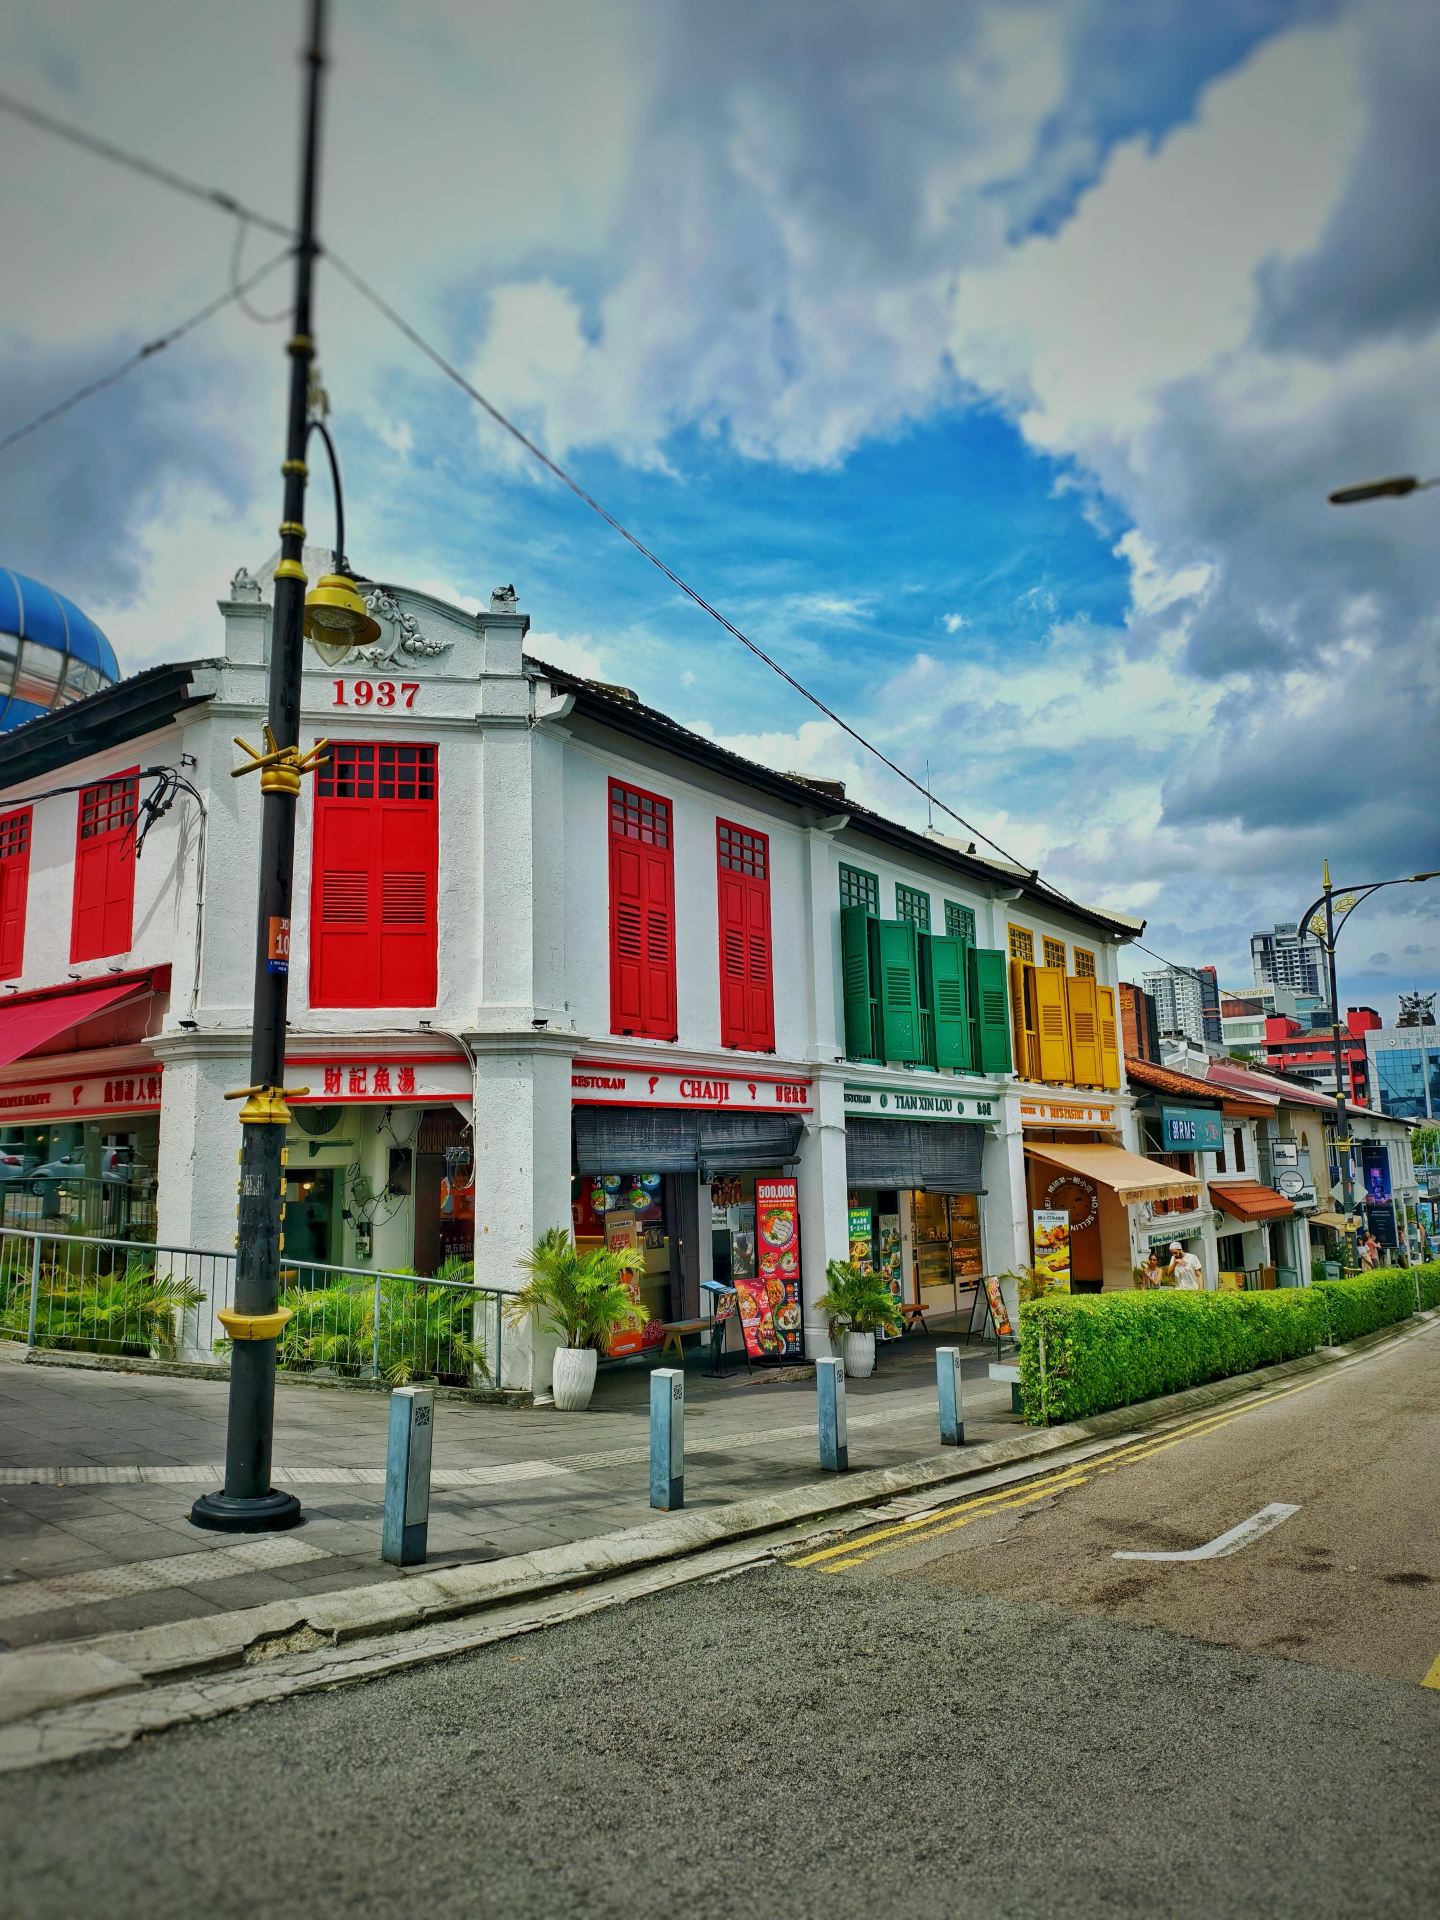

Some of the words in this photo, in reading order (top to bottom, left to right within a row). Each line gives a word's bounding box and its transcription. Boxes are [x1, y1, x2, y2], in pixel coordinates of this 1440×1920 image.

[332, 680, 420, 708] 1937
[323, 1065, 416, 1095] 財記魚湯
[679, 1079, 730, 1103] CHAIJI
[894, 1095, 919, 1110] TIAN
[919, 1097, 934, 1111] XIN
[936, 1098, 953, 1112] LOU
